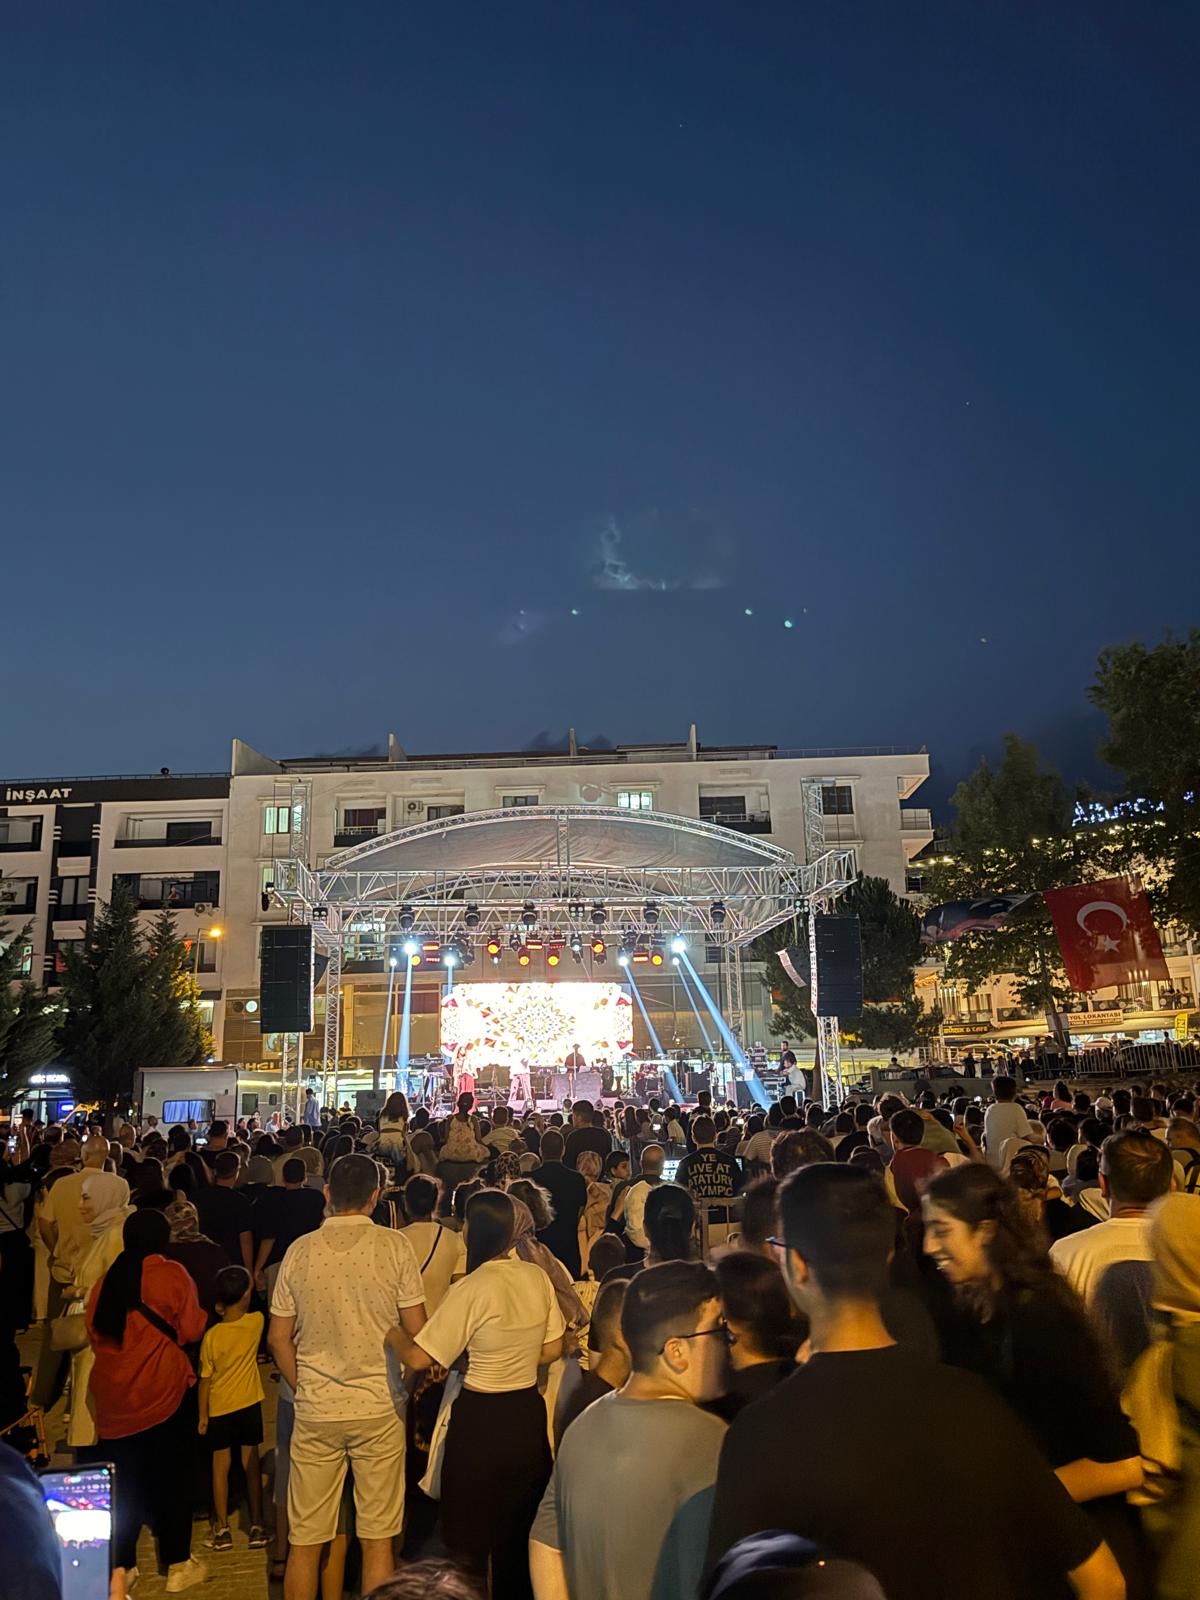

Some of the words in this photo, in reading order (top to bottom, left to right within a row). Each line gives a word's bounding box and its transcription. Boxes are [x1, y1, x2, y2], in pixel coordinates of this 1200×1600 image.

[6, 787, 73, 803] İNŞAAT
[700, 1153, 717, 1162] YE
[688, 1162, 713, 1176] LIVE
[716, 1163, 731, 1174] AT
